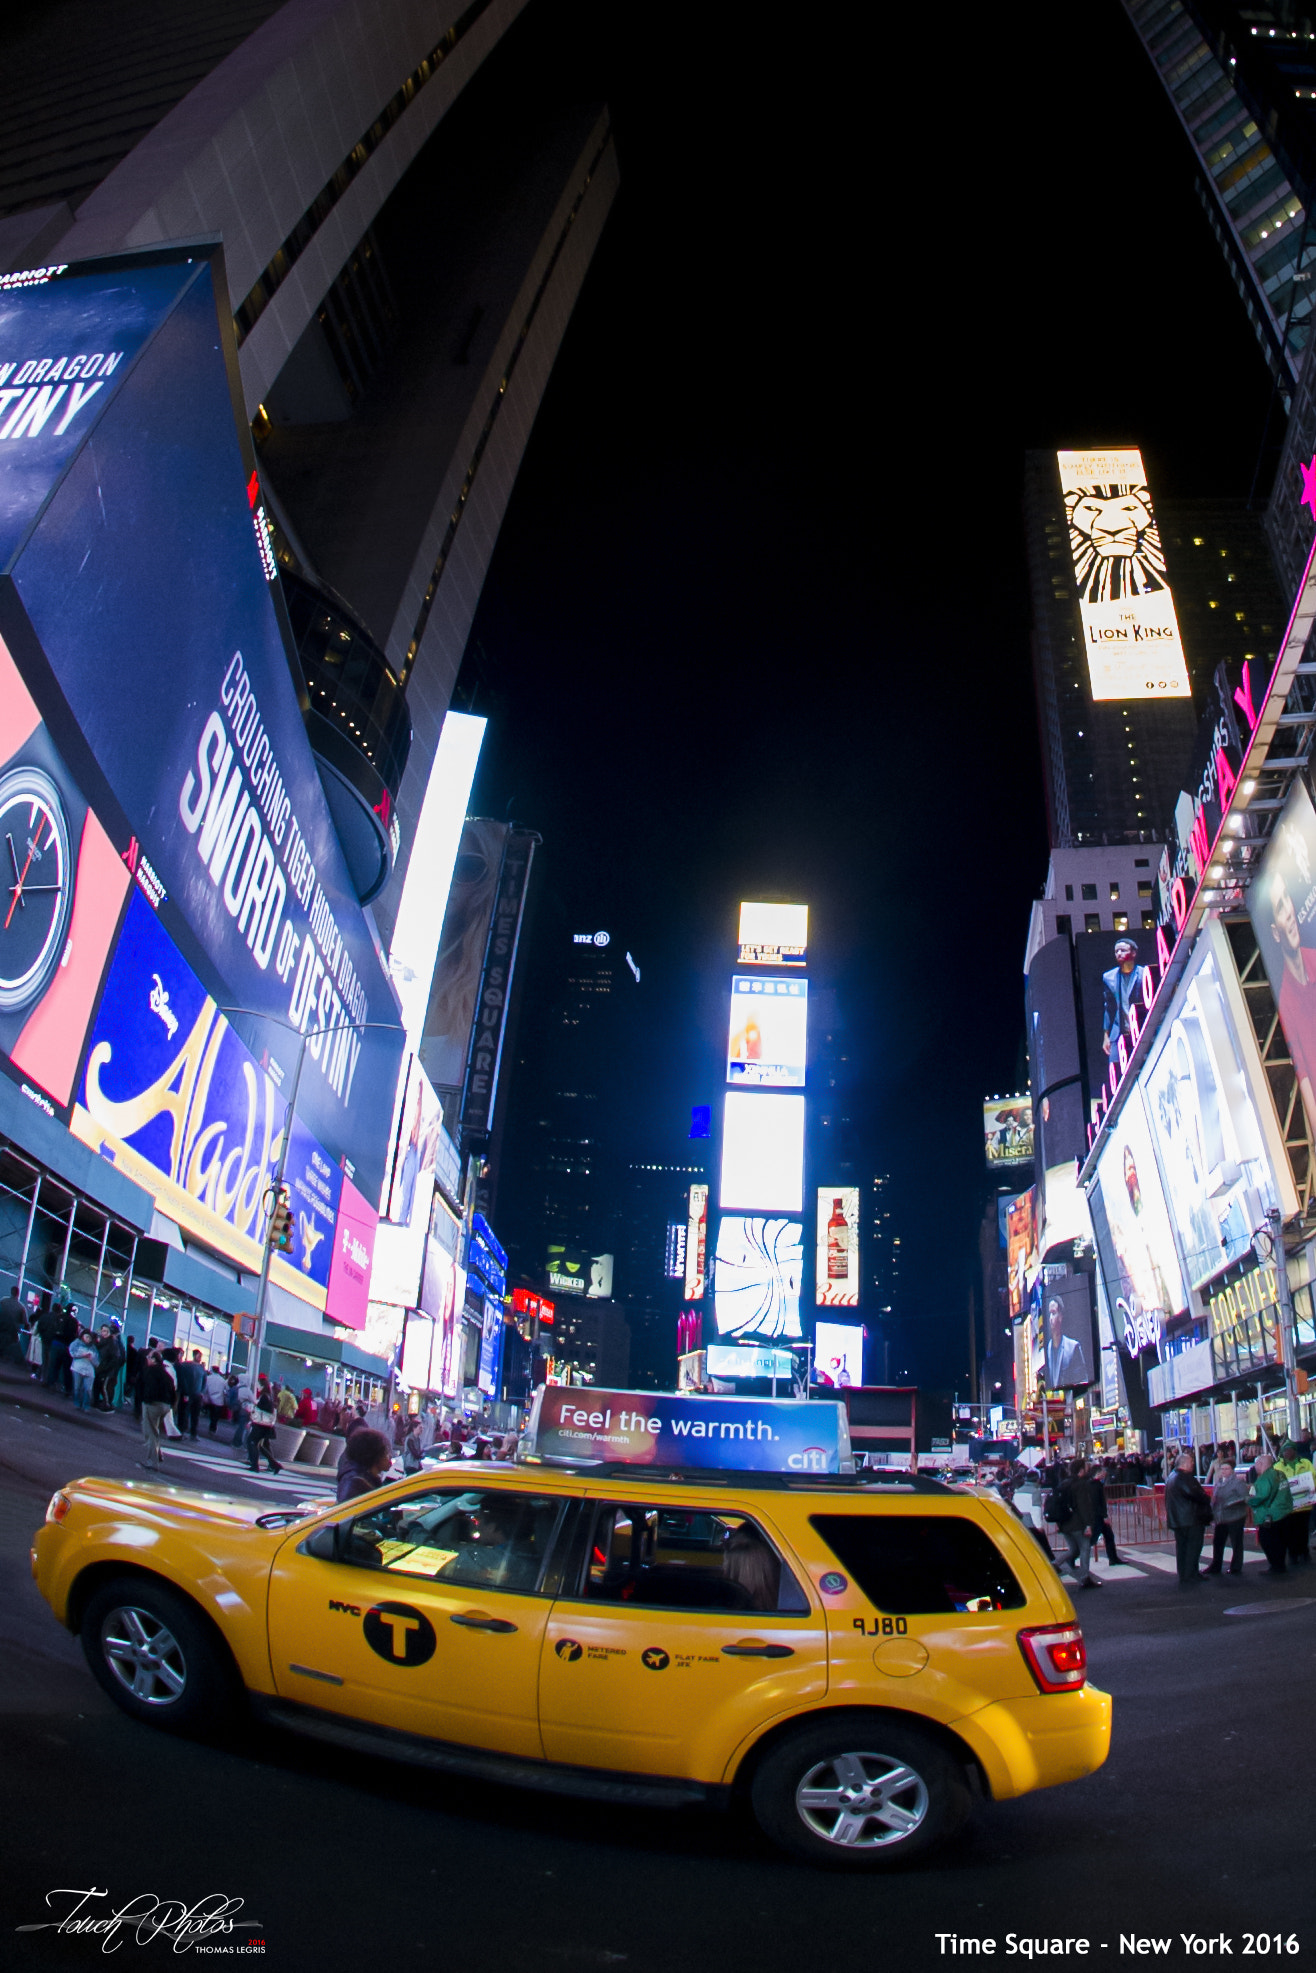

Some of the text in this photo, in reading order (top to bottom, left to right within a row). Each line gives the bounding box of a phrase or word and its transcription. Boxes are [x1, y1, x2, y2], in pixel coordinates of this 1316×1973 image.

[0, 264, 68, 285] ARRIOTT
[12, 351, 125, 386] DRAGON
[221, 650, 292, 842] CROUCHING
[283, 813, 317, 912] TIGER
[309, 877, 346, 967] HIDDEN
[180, 712, 288, 971] SWORD
[275, 919, 300, 983] OF
[288, 934, 362, 1108] DESTINY
[471, 859, 524, 1095] TIMES SQUARE
[1209, 1267, 1282, 1345] FOREVER
[560, 1404, 780, 1441] Feel the warmth.
[787, 1447, 828, 1469] citi
[328, 1599, 362, 1618] NYC
[378, 1612, 420, 1659] T
